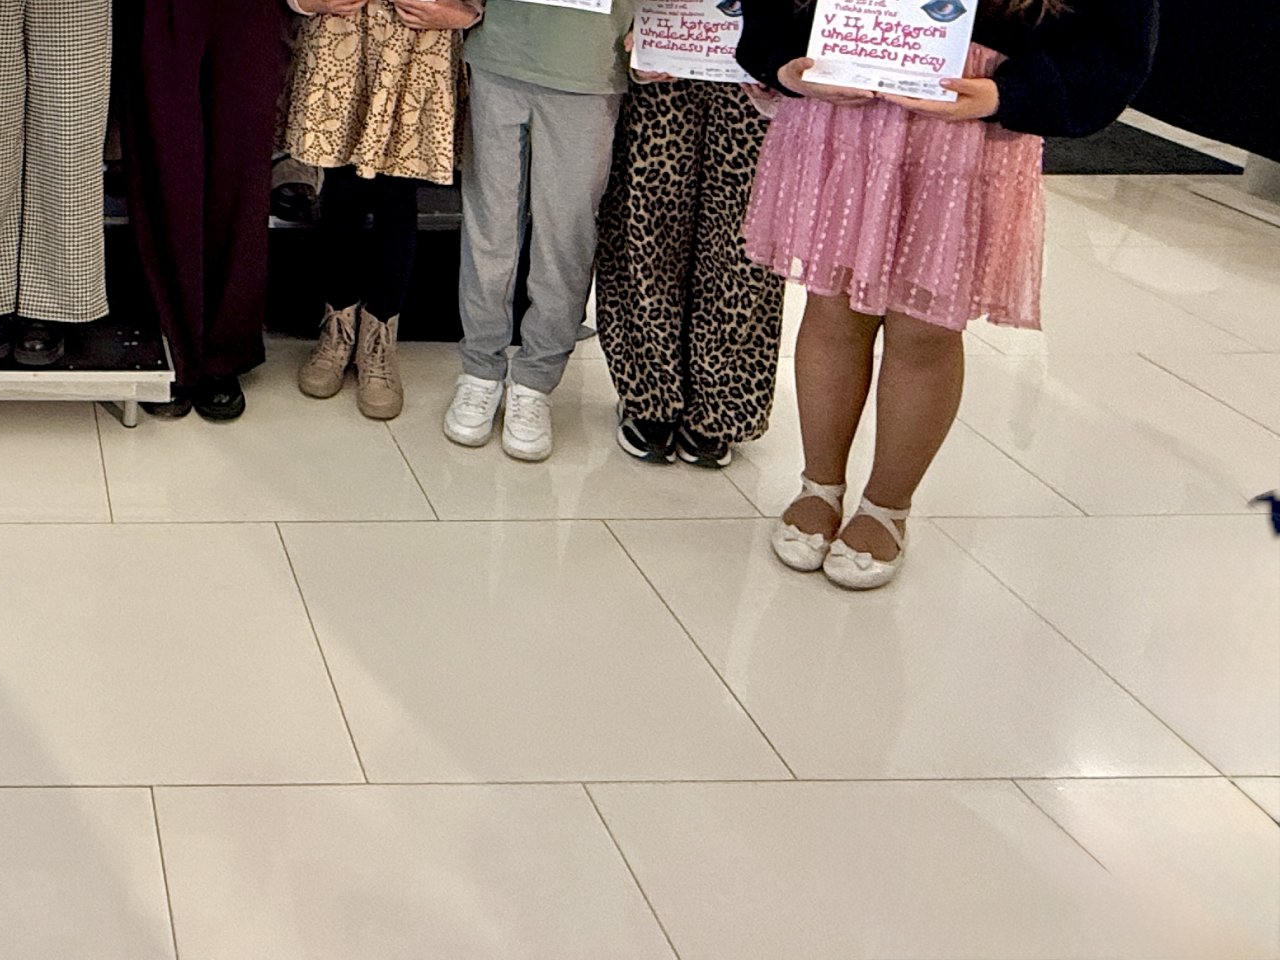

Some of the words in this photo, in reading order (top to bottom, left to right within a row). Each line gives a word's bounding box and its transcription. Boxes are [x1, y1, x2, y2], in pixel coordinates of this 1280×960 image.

[681, 17, 739, 33] kategórii
[873, 16, 947, 39] kategórii
[641, 28, 721, 43] umeleckého
[821, 28, 922, 50] umeleckého
[642, 39, 703, 53] prednesu
[821, 42, 898, 61] prednesu
[901, 51, 945, 72] prózy
